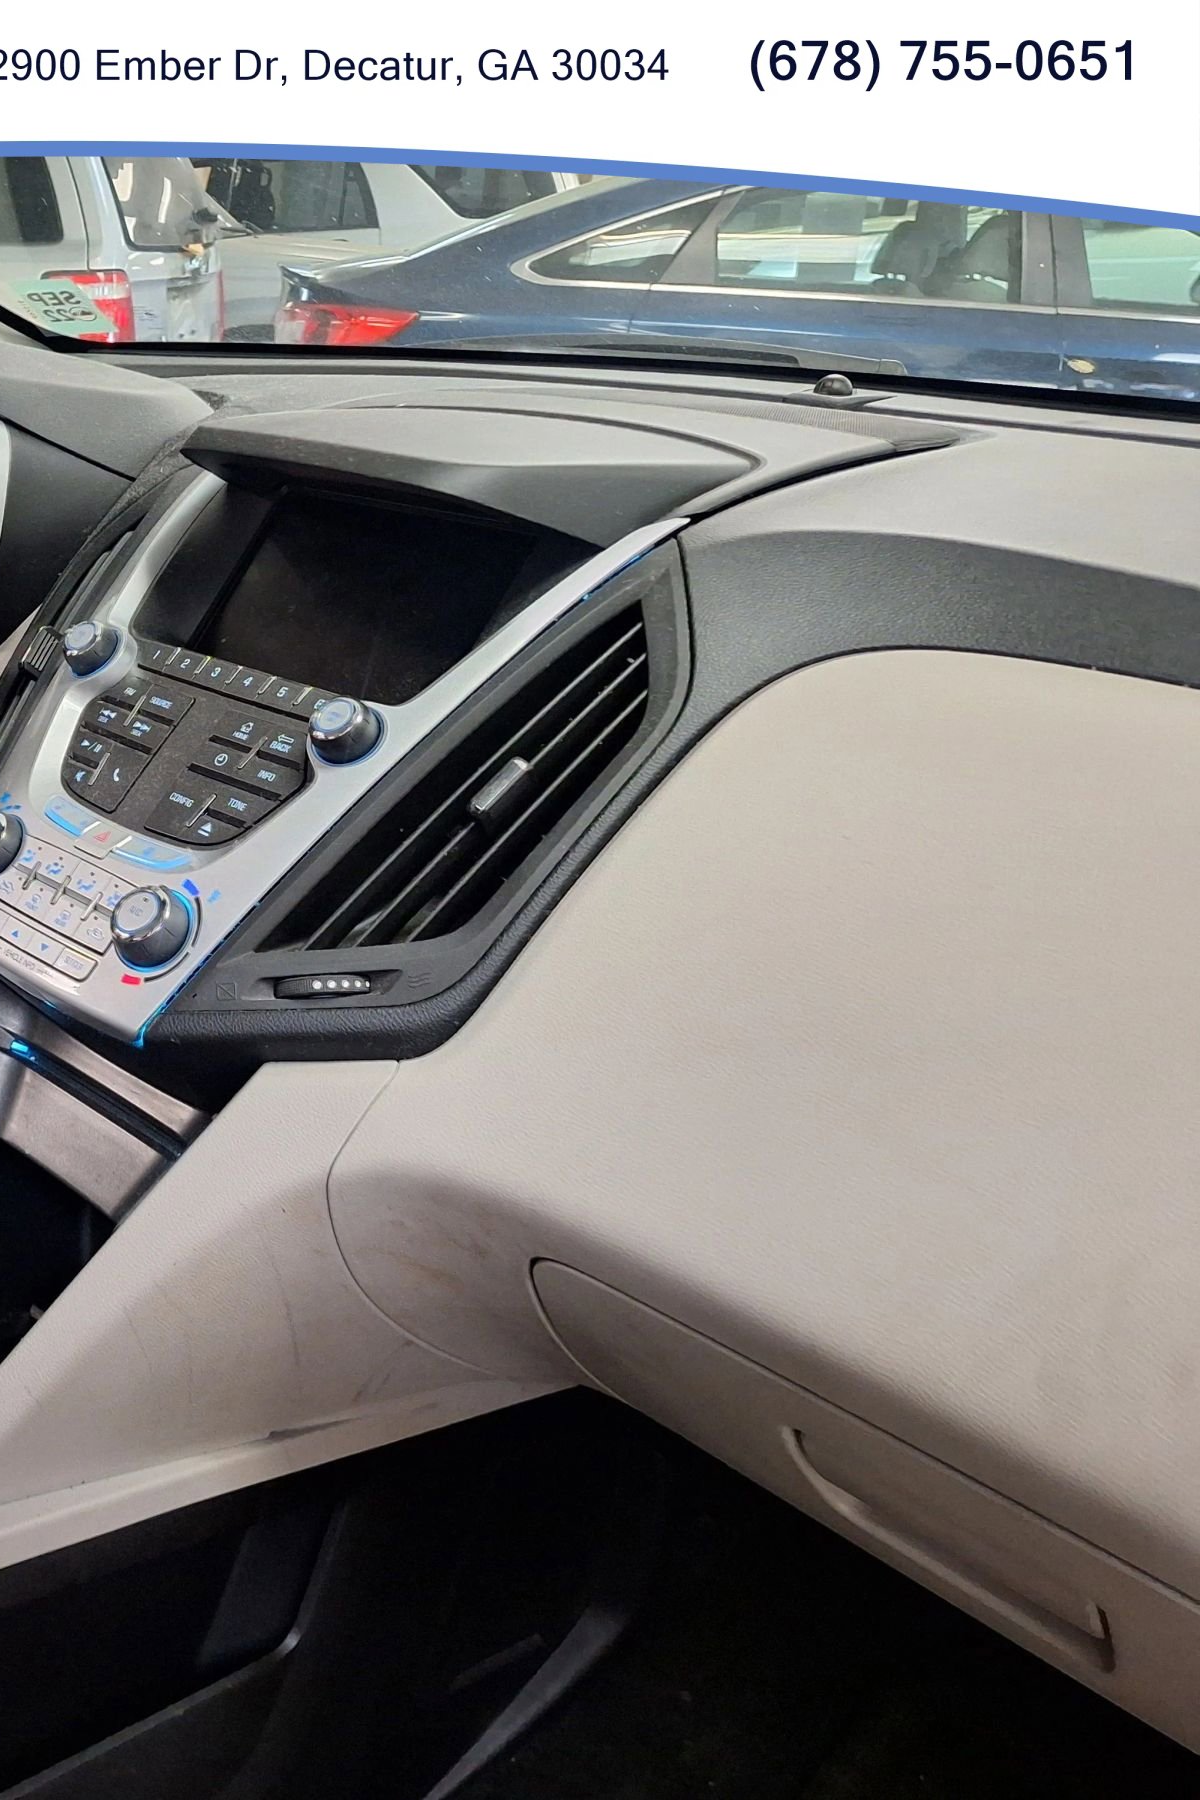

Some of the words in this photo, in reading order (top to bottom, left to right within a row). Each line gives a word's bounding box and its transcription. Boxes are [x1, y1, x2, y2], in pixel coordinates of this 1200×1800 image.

[180, 658, 191, 669] 2
[210, 667, 222, 678] 3
[242, 676, 254, 688] 4
[276, 686, 289, 698] 5
[232, 731, 249, 740] HOME
[269, 740, 292, 753] BACK
[257, 769, 276, 782] INFO
[169, 792, 194, 808] CONFIG
[227, 797, 248, 811] TONE
